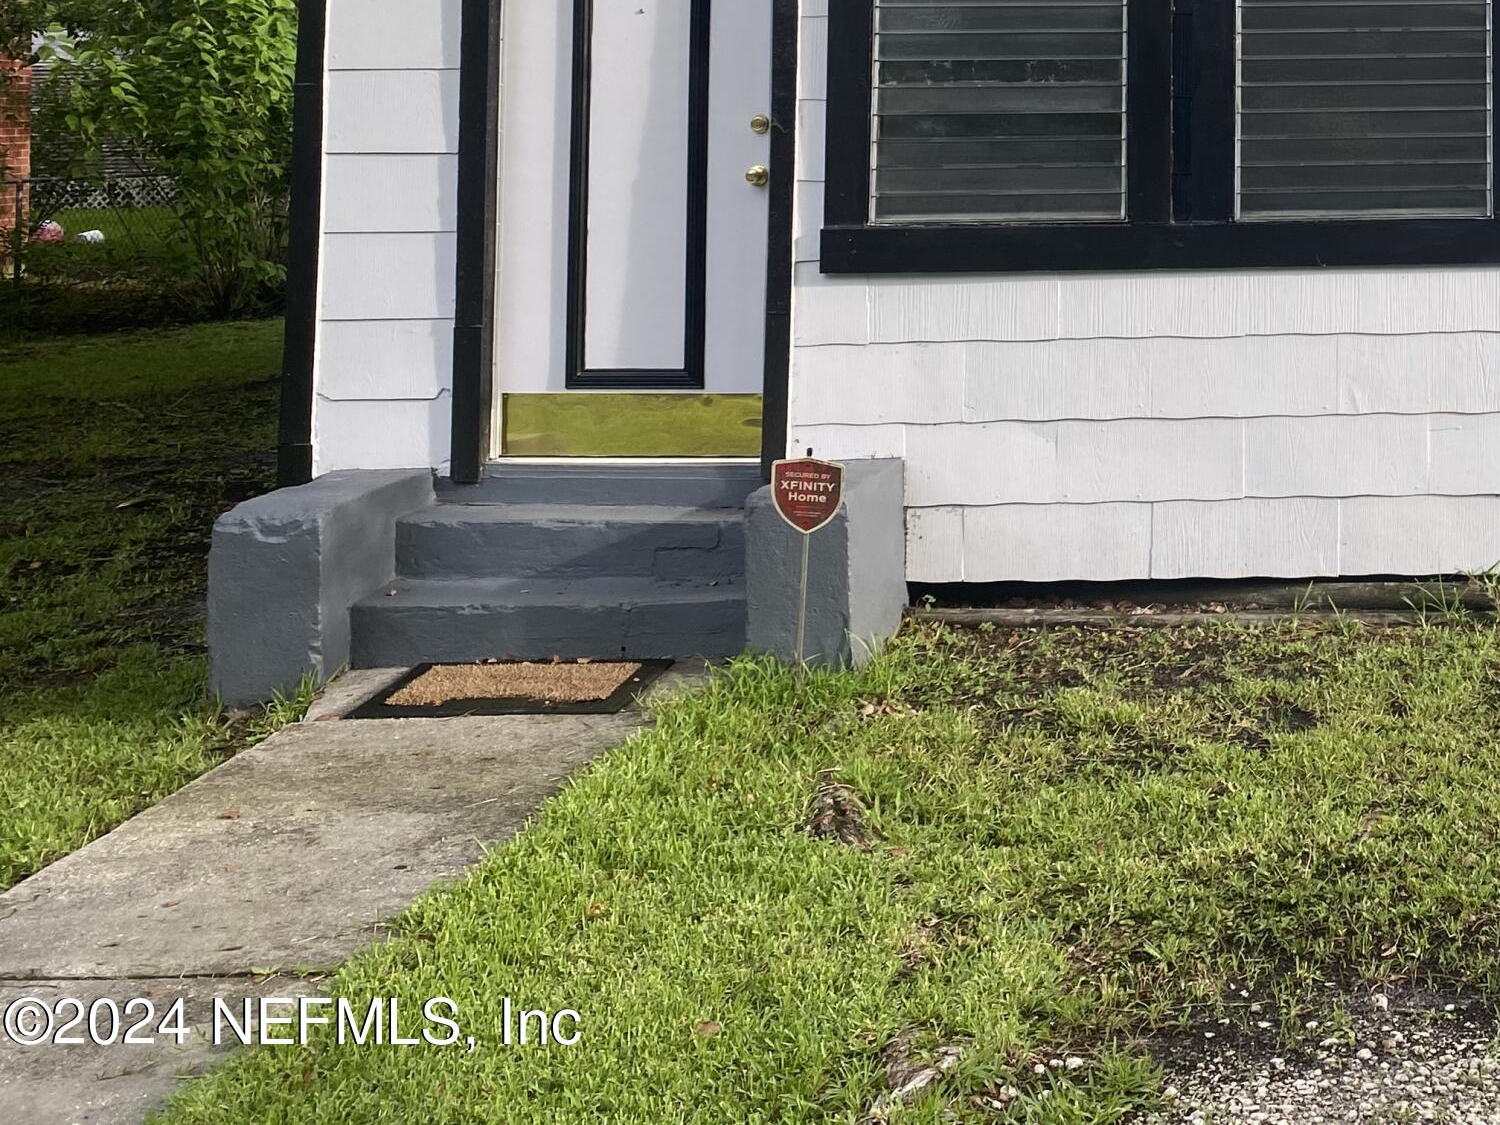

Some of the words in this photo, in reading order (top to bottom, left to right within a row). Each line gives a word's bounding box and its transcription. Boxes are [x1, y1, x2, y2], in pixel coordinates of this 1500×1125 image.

[785, 471, 820, 479] SECURED
[780, 480, 835, 492] XFINITY
[788, 491, 827, 503] Home
